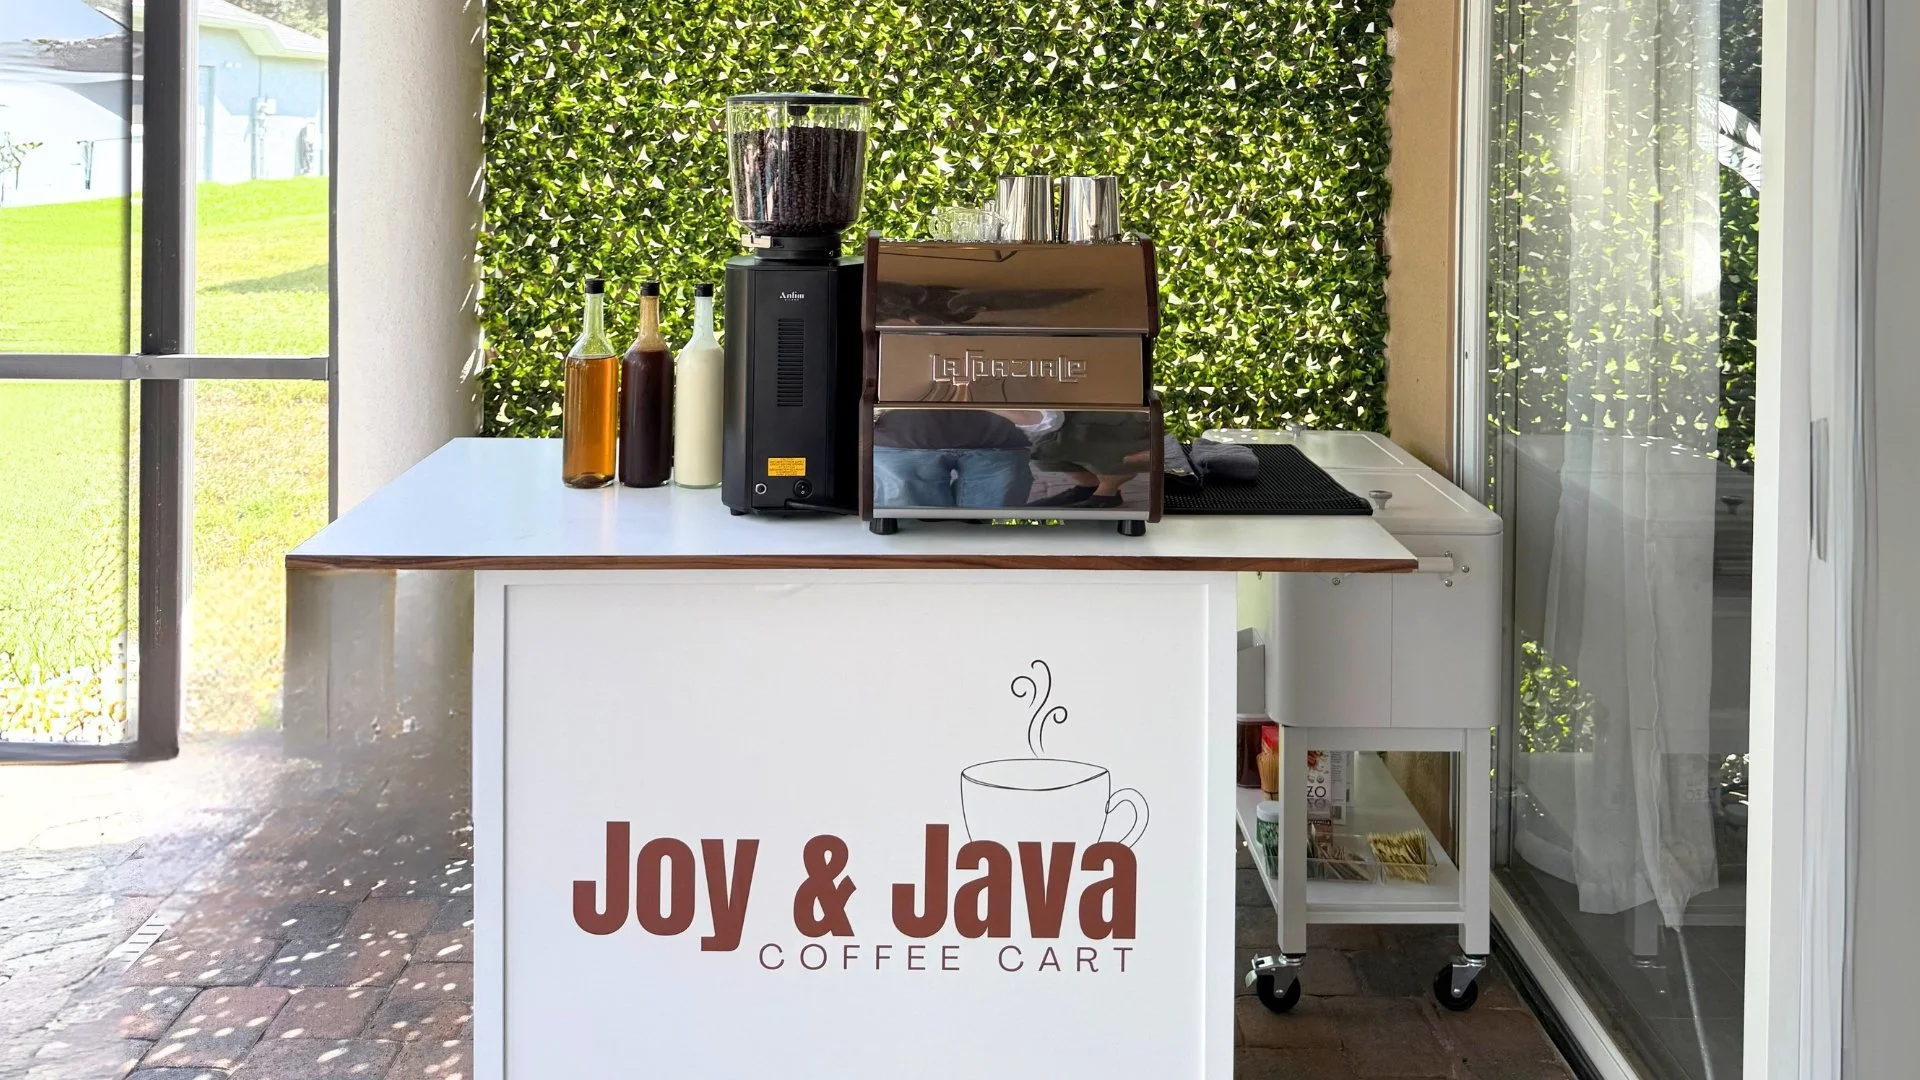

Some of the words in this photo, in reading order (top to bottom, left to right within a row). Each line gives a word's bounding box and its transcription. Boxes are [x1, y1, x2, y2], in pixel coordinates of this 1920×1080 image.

[1307, 785, 1327, 798] ZO
[573, 821, 760, 952] Joy
[793, 834, 857, 938] &
[891, 824, 1137, 940] Java
[759, 943, 960, 971] COFFEE
[998, 946, 1134, 973] CART
